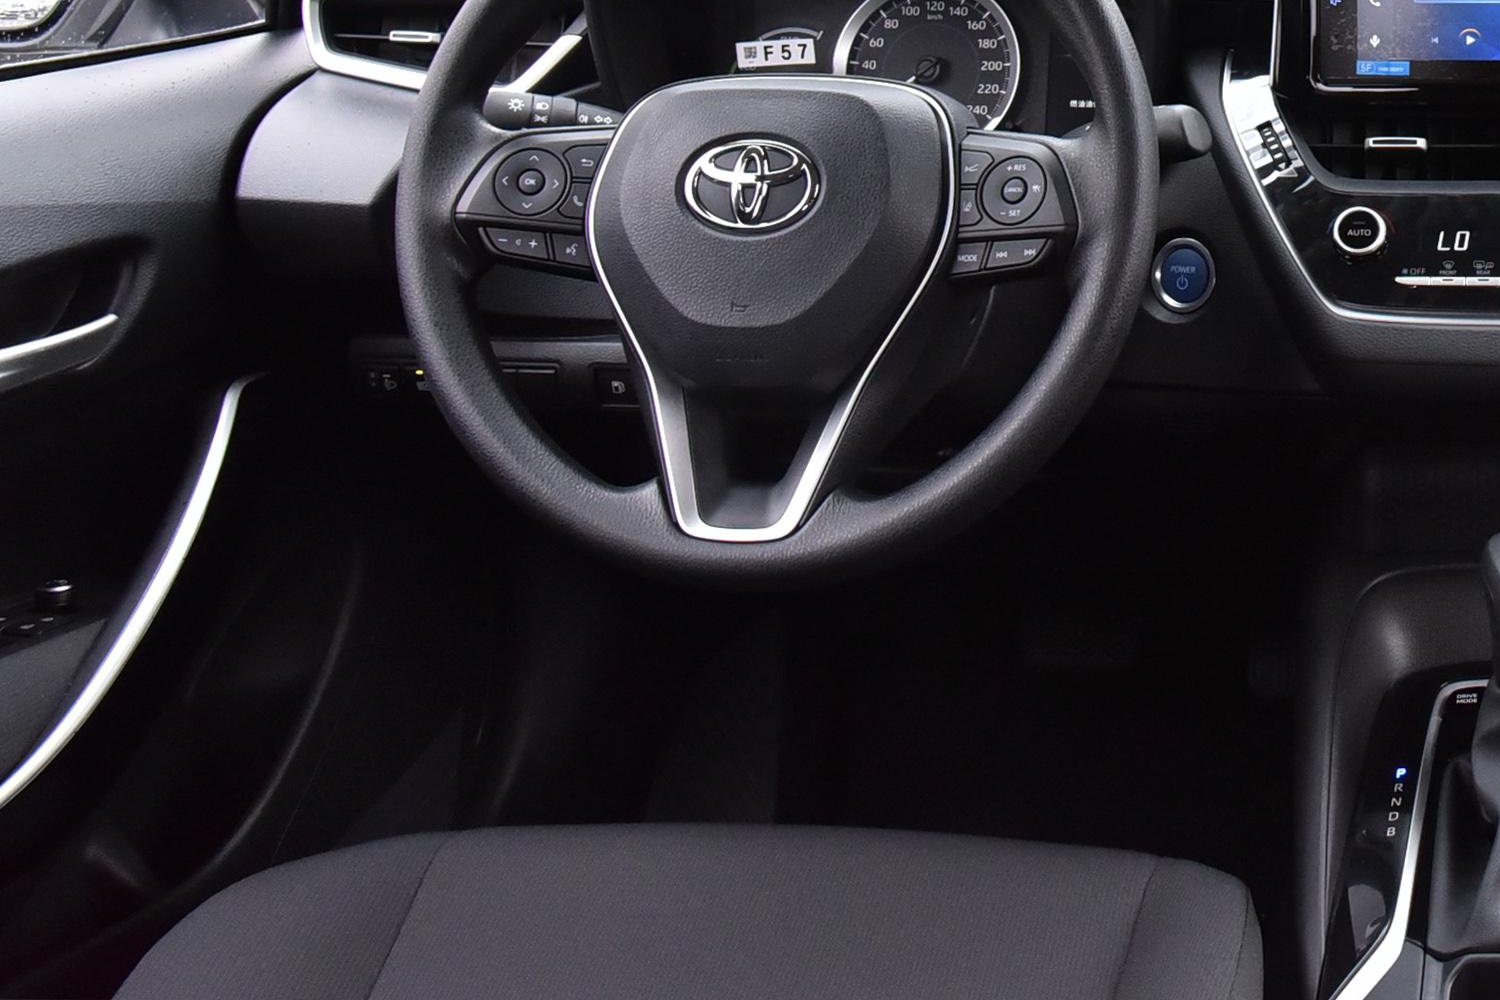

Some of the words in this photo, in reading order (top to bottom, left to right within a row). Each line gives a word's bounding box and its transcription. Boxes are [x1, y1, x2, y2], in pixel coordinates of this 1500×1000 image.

[901, 5, 920, 16] 100
[925, 1, 945, 12] 120
[949, 5, 969, 17] 140
[884, 18, 899, 30] 80
[966, 19, 986, 31] 160
[869, 37, 884, 48] 60
[977, 38, 998, 49] 180
[862, 59, 877, 71] 40
[980, 59, 1003, 71] 200
[977, 84, 999, 95] 220
[967, 104, 988, 115] 240
[1347, 229, 1372, 237] AUTO
[1437, 230, 1470, 251] LO
[958, 254, 978, 262] MODE
[1170, 265, 1197, 273] POWER
[1395, 767, 1407, 779] P
[1394, 783, 1404, 792] R
[1391, 797, 1402, 807] N
[1388, 811, 1399, 821] D
[1386, 826, 1396, 837] B
